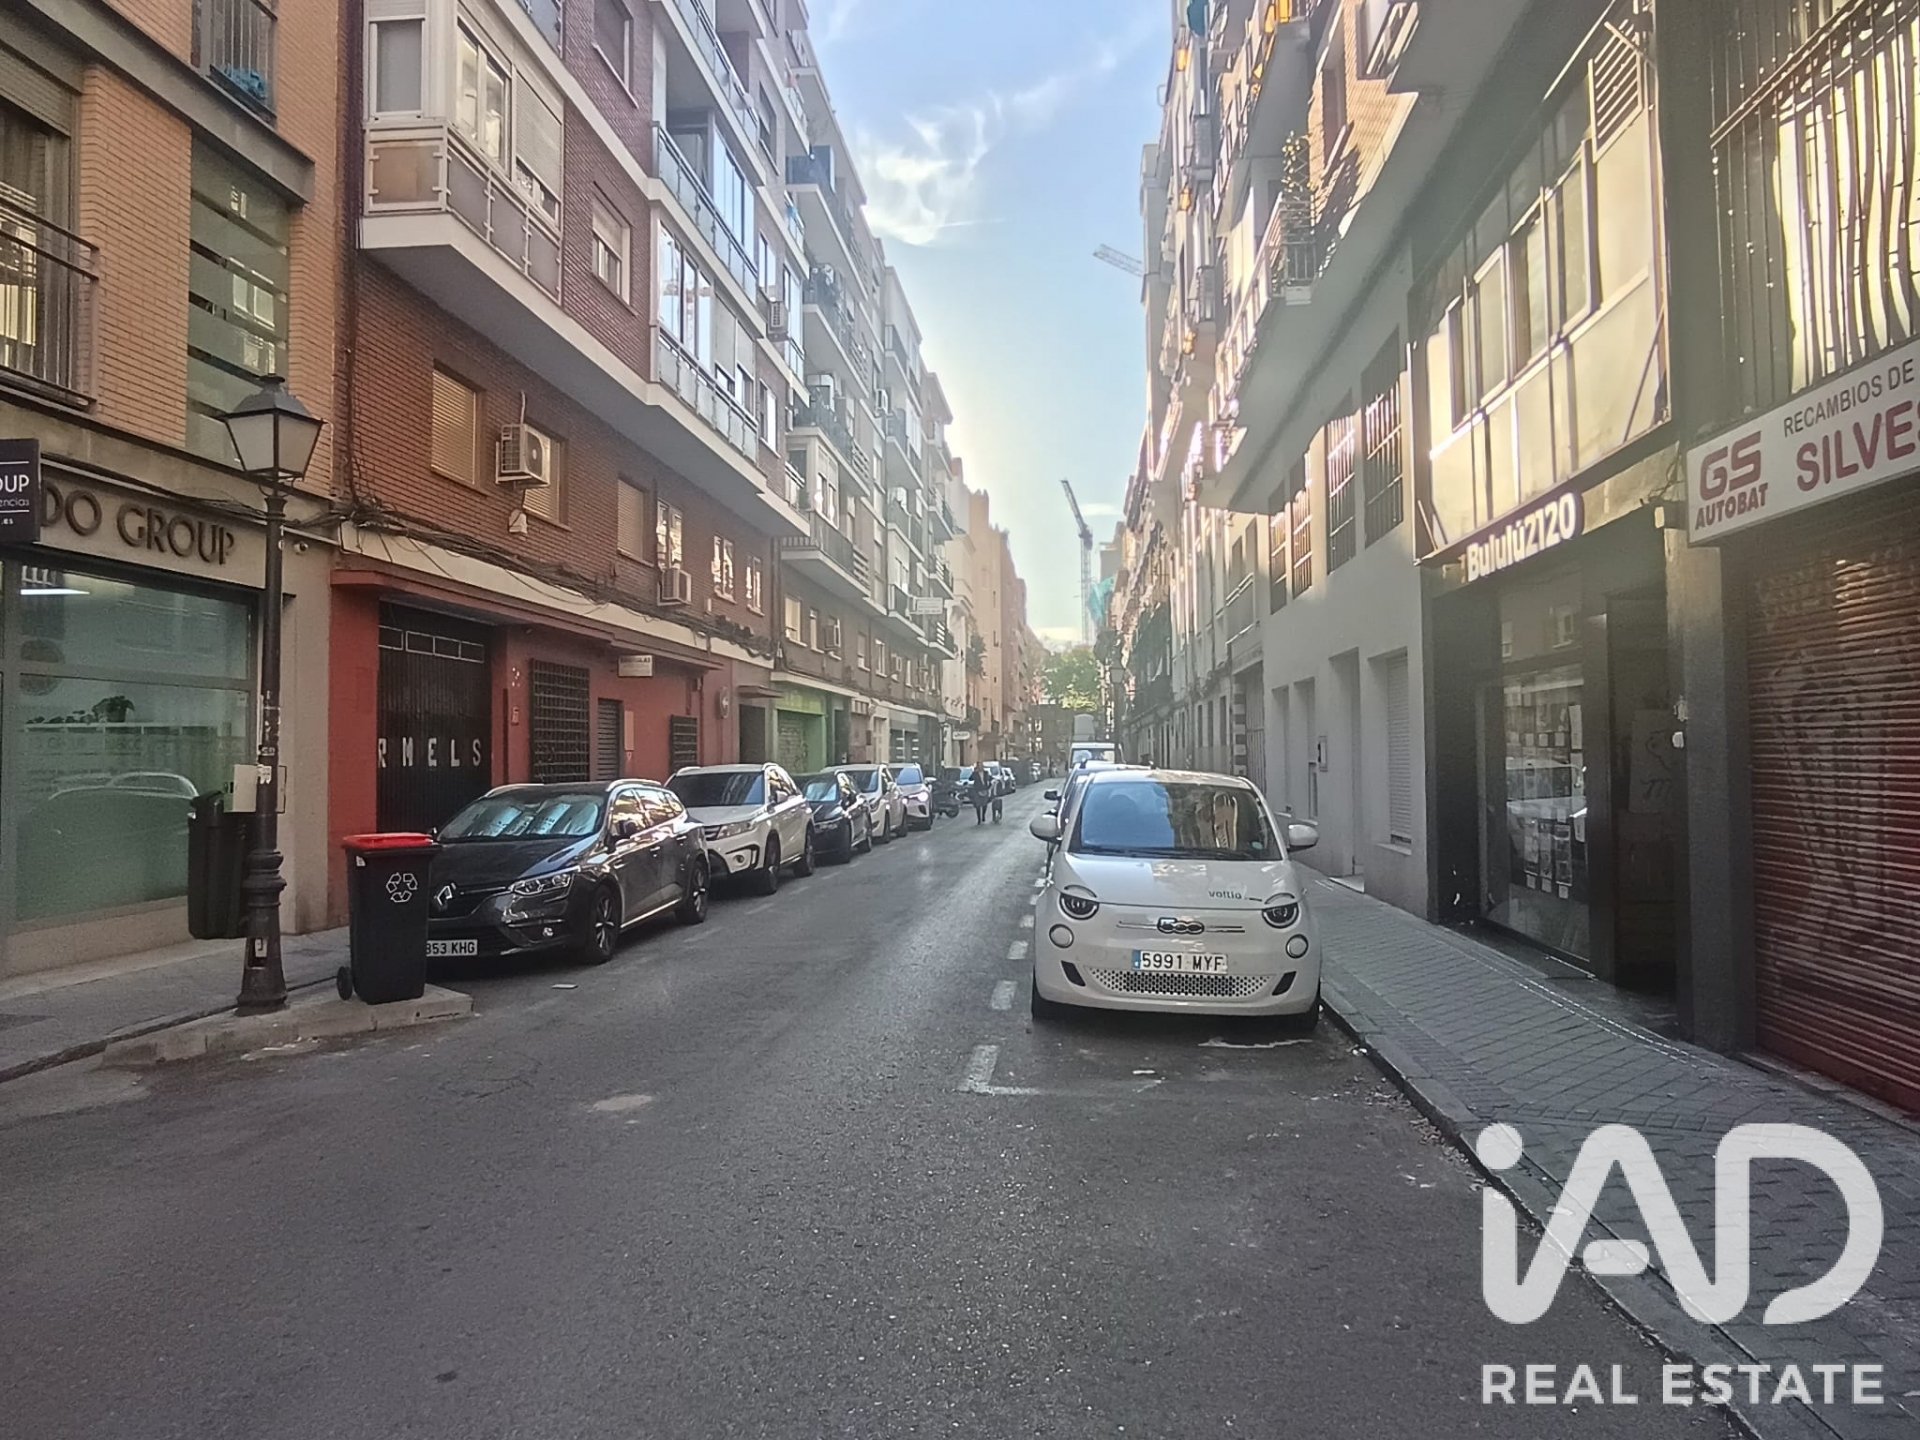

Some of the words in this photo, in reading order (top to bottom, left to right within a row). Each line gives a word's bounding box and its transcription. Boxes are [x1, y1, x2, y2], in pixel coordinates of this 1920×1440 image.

[1783, 375, 1882, 437] RECAMBIOS
[1888, 359, 1915, 390] DE
[1700, 430, 1762, 501] GS
[1796, 400, 1920, 492] SILVE
[0, 474, 30, 493] UP
[1695, 482, 1768, 530] AUTOBAT
[116, 502, 234, 565] GROUP
[451, 941, 475, 954] KHG
[1142, 952, 1183, 970] 5991
[1193, 954, 1224, 971] MYF
